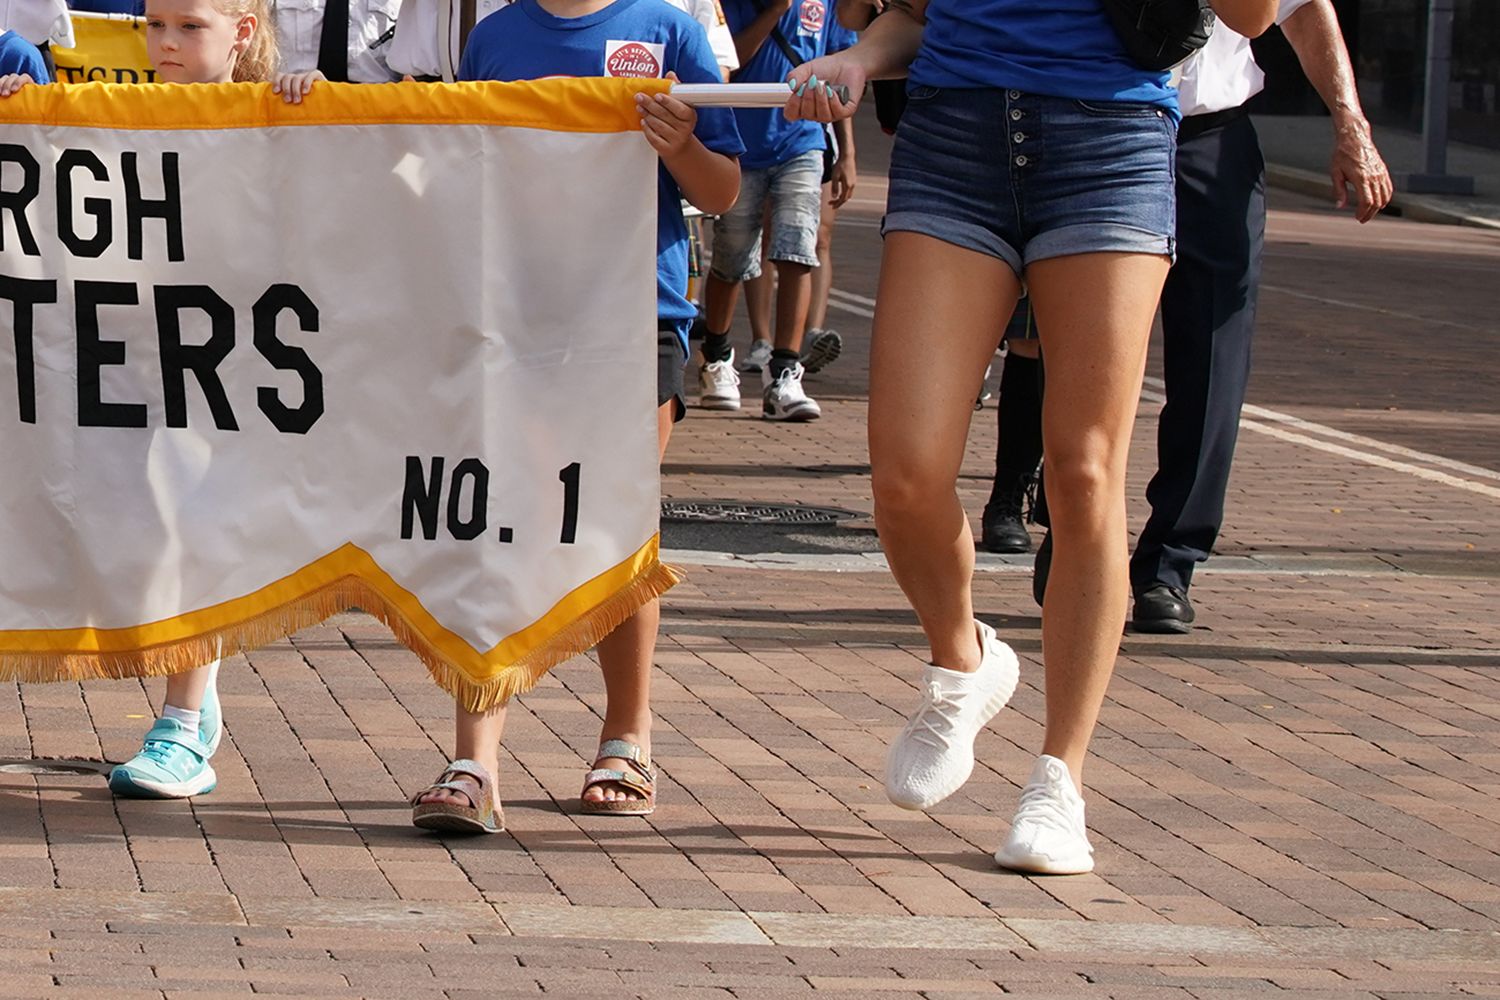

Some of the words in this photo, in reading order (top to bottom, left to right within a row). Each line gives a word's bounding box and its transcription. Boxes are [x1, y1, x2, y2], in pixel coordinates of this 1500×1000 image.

[616, 48, 629, 57] IT'S
[610, 58, 657, 73] Union
[401, 456, 513, 544] NO.
[560, 463, 581, 544] 1
